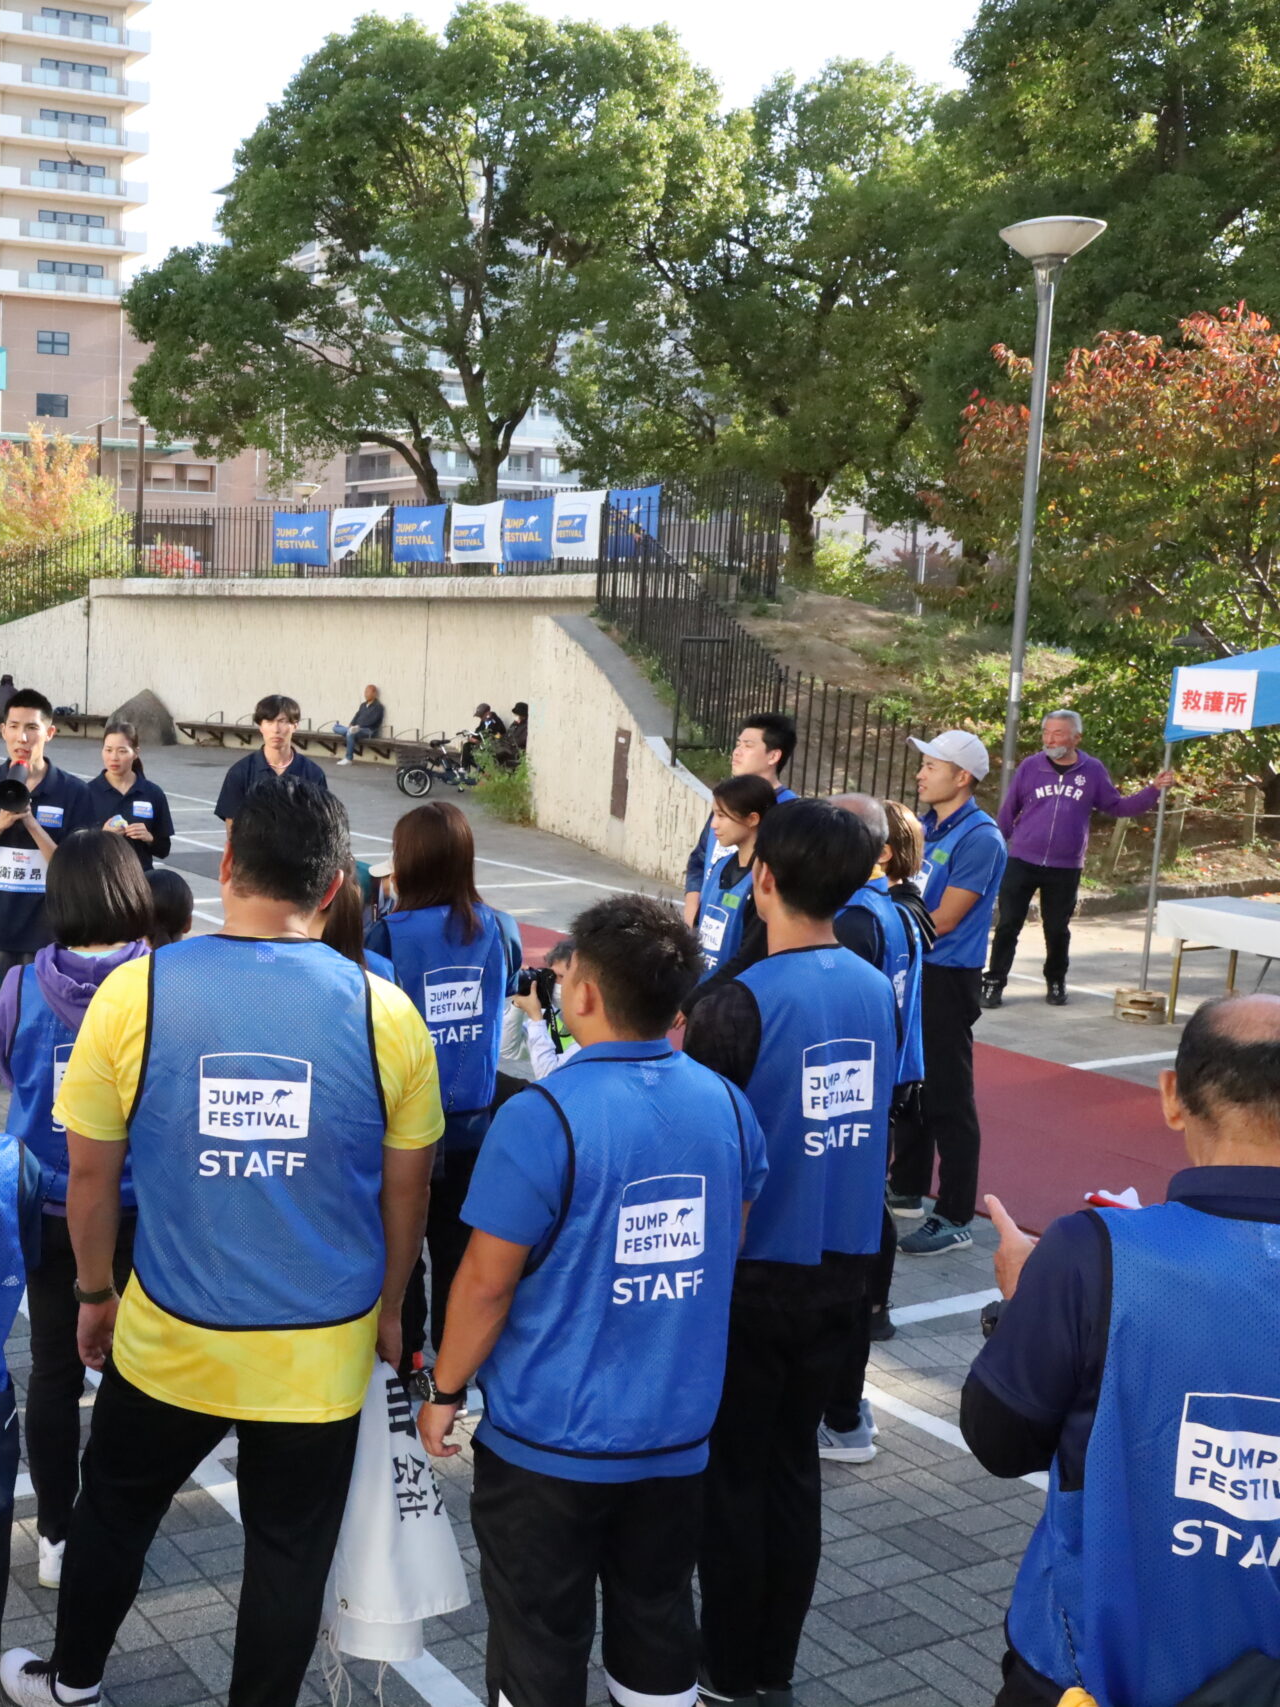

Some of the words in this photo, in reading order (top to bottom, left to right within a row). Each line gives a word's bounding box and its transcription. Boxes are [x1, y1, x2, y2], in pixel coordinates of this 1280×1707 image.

[396, 523, 417, 533] JUMP
[504, 518, 524, 528] JUMP
[557, 519, 572, 528] JUMP
[276, 528, 298, 538] JUMP
[395, 535, 435, 545] FESTIVAL
[454, 529, 470, 537] JUMP
[556, 529, 583, 538] FESTIVAL
[276, 539, 319, 549] FESTIVAL
[454, 538, 482, 546] FESTIVAL
[1182, 689, 1248, 714] 救護所
[1035, 784, 1084, 801] NEVER
[430, 990, 457, 1002] JUMP
[430, 1002, 478, 1016] FESTIVAL
[430, 1024, 483, 1047] STAFF
[810, 1073, 840, 1090] JUMP
[208, 1090, 264, 1105] JUMP
[811, 1089, 865, 1110] FETIVAL
[208, 1111, 300, 1129] FESTIVAL
[804, 1123, 871, 1157] SAFF
[198, 1150, 306, 1177] STAFF
[624, 1212, 669, 1233] JUMP
[624, 1231, 701, 1254] FESTIVAL
[612, 1268, 704, 1305] STAFF
[1192, 1438, 1278, 1470] JUMP
